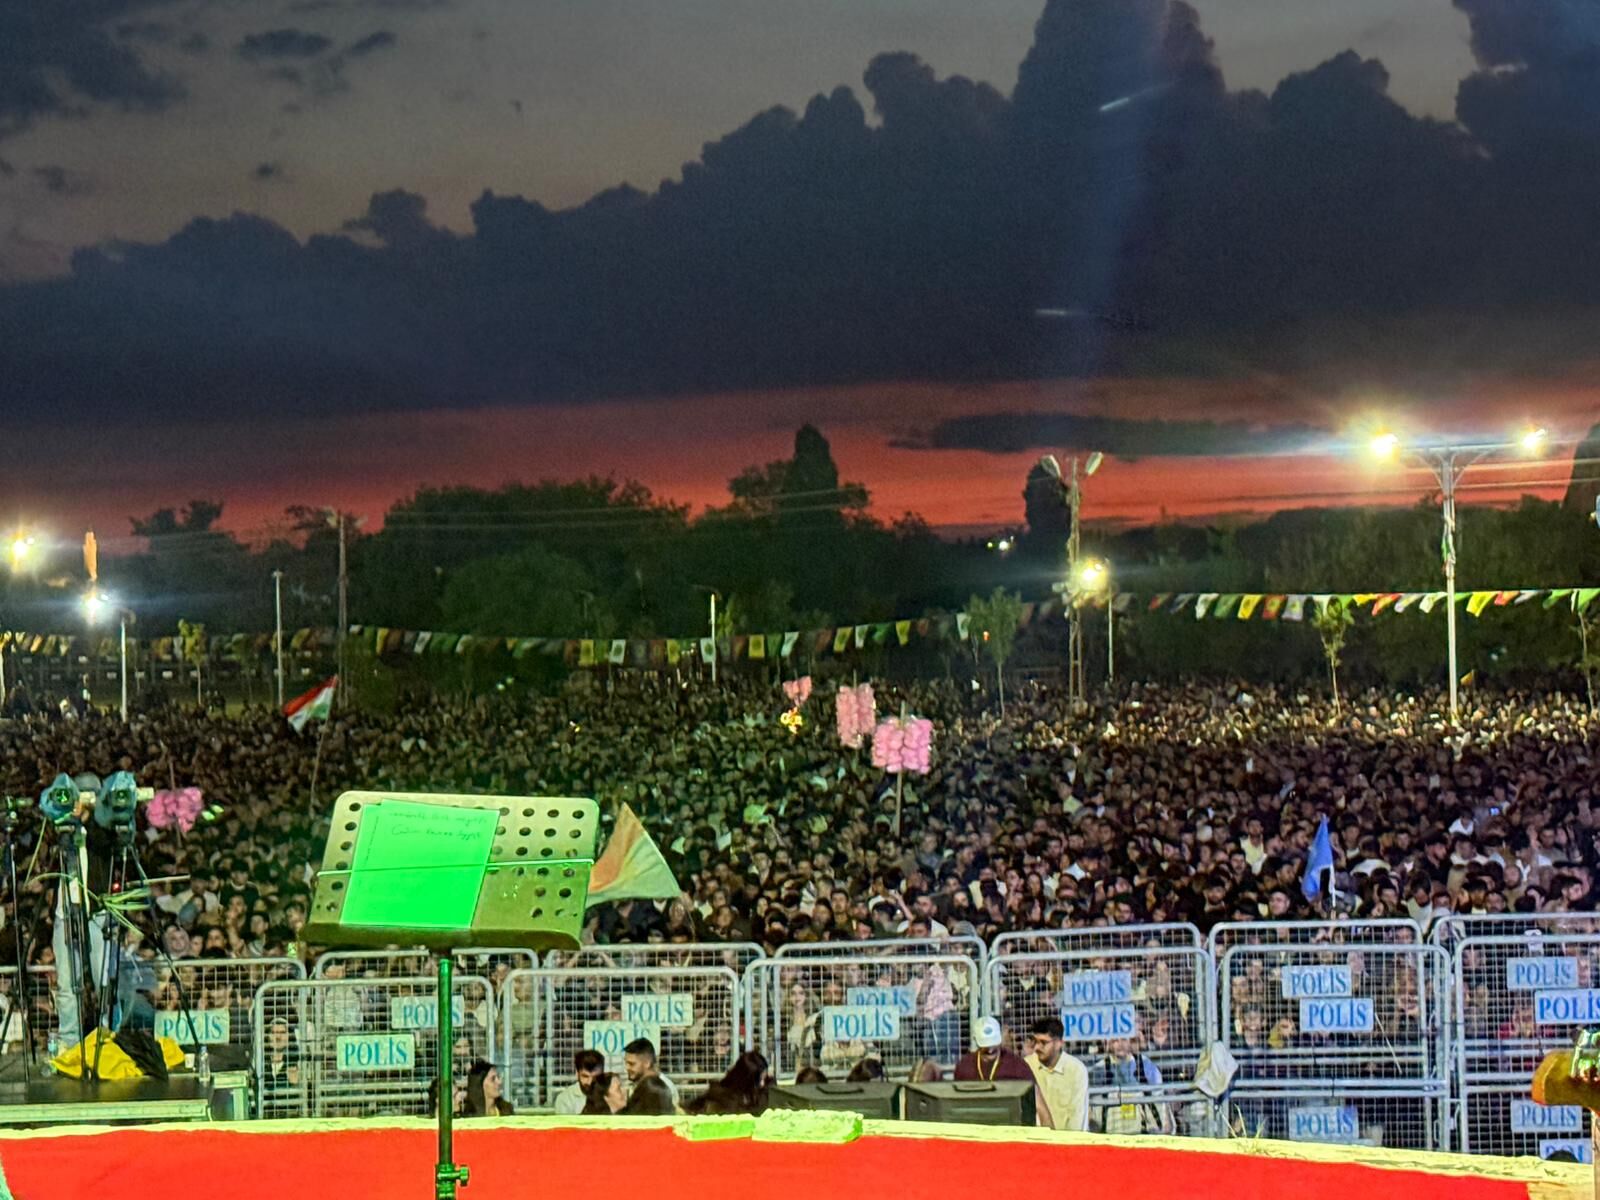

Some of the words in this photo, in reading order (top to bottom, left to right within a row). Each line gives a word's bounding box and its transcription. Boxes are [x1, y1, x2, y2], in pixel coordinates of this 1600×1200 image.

[1071, 973, 1125, 1003] POLİS
[1291, 967, 1347, 995] POLİS
[627, 995, 685, 1025] POLİS
[832, 1007, 894, 1038] POLİS
[1064, 1004, 1133, 1037] POLİS
[1308, 999, 1368, 1028] POLİS
[344, 1036, 408, 1067] POLİS
[1295, 1107, 1354, 1136] POLİS
